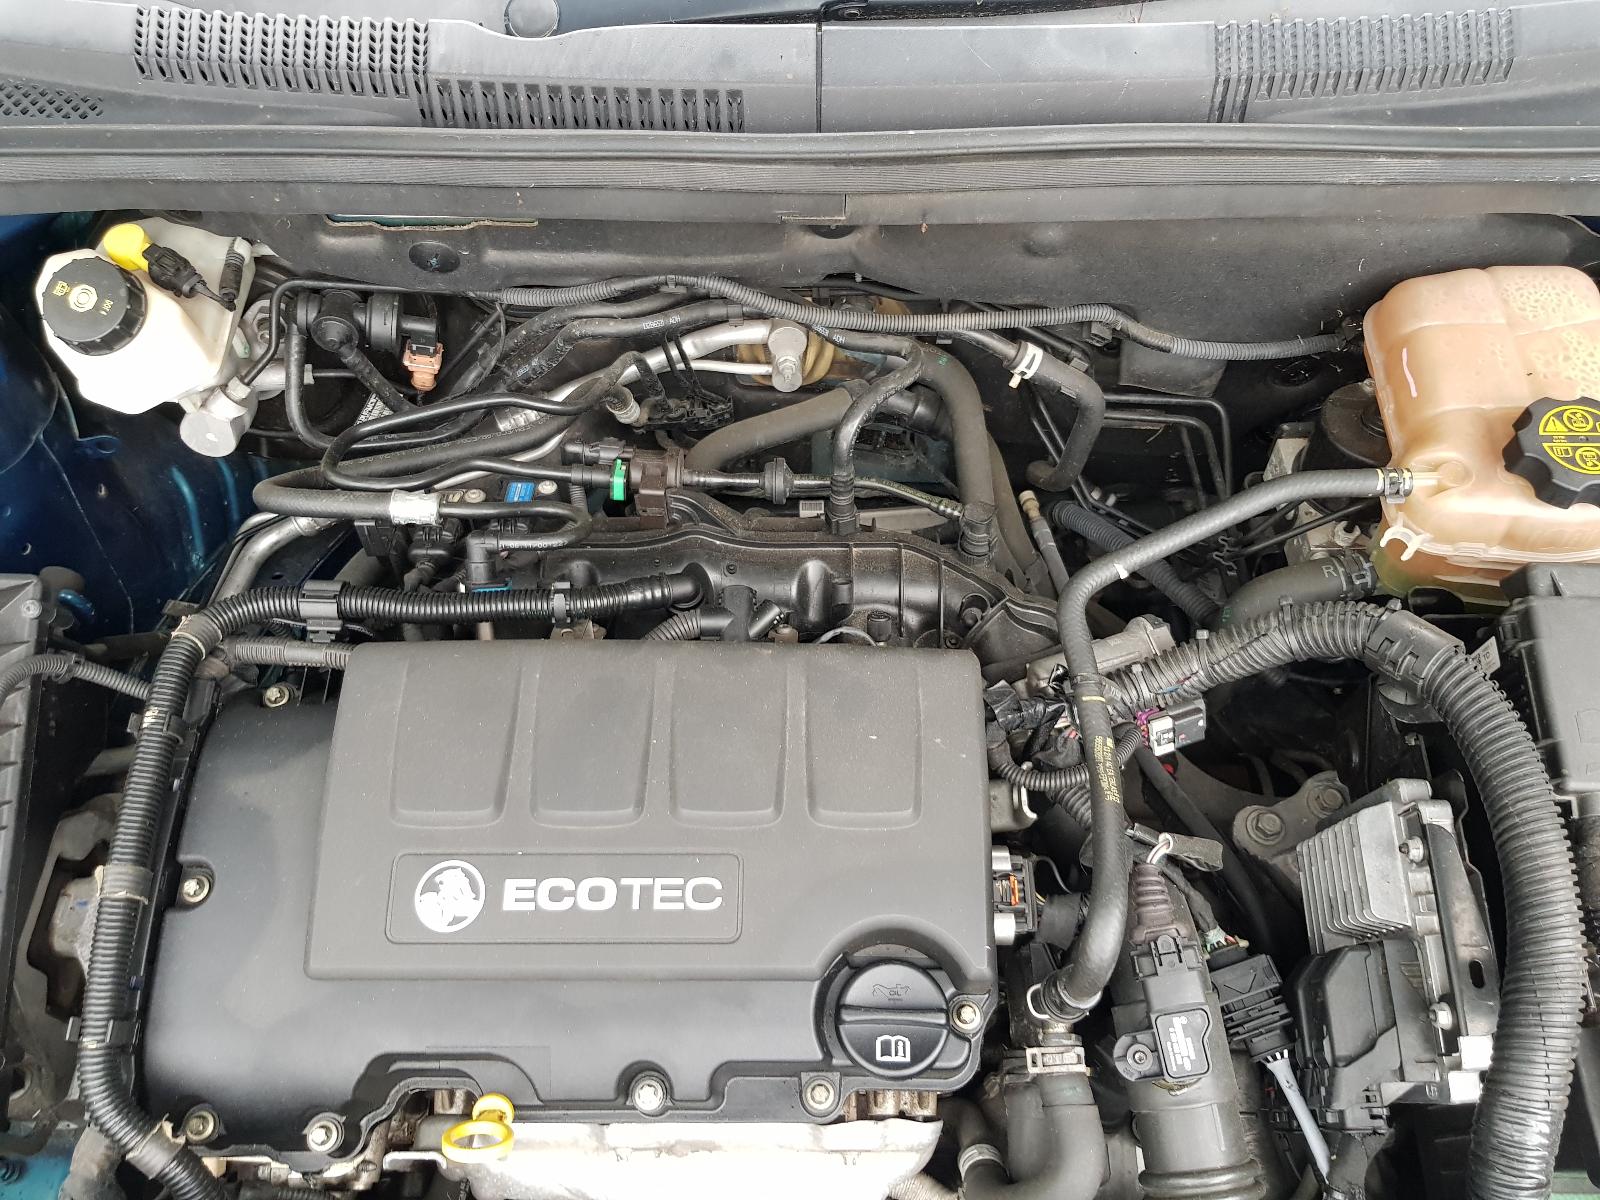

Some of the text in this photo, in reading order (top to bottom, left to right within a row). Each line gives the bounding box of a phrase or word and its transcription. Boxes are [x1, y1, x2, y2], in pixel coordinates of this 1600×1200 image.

[1321, 565, 1338, 578] R
[502, 877, 723, 911] ECOTEC
[888, 989, 902, 997] OIL
